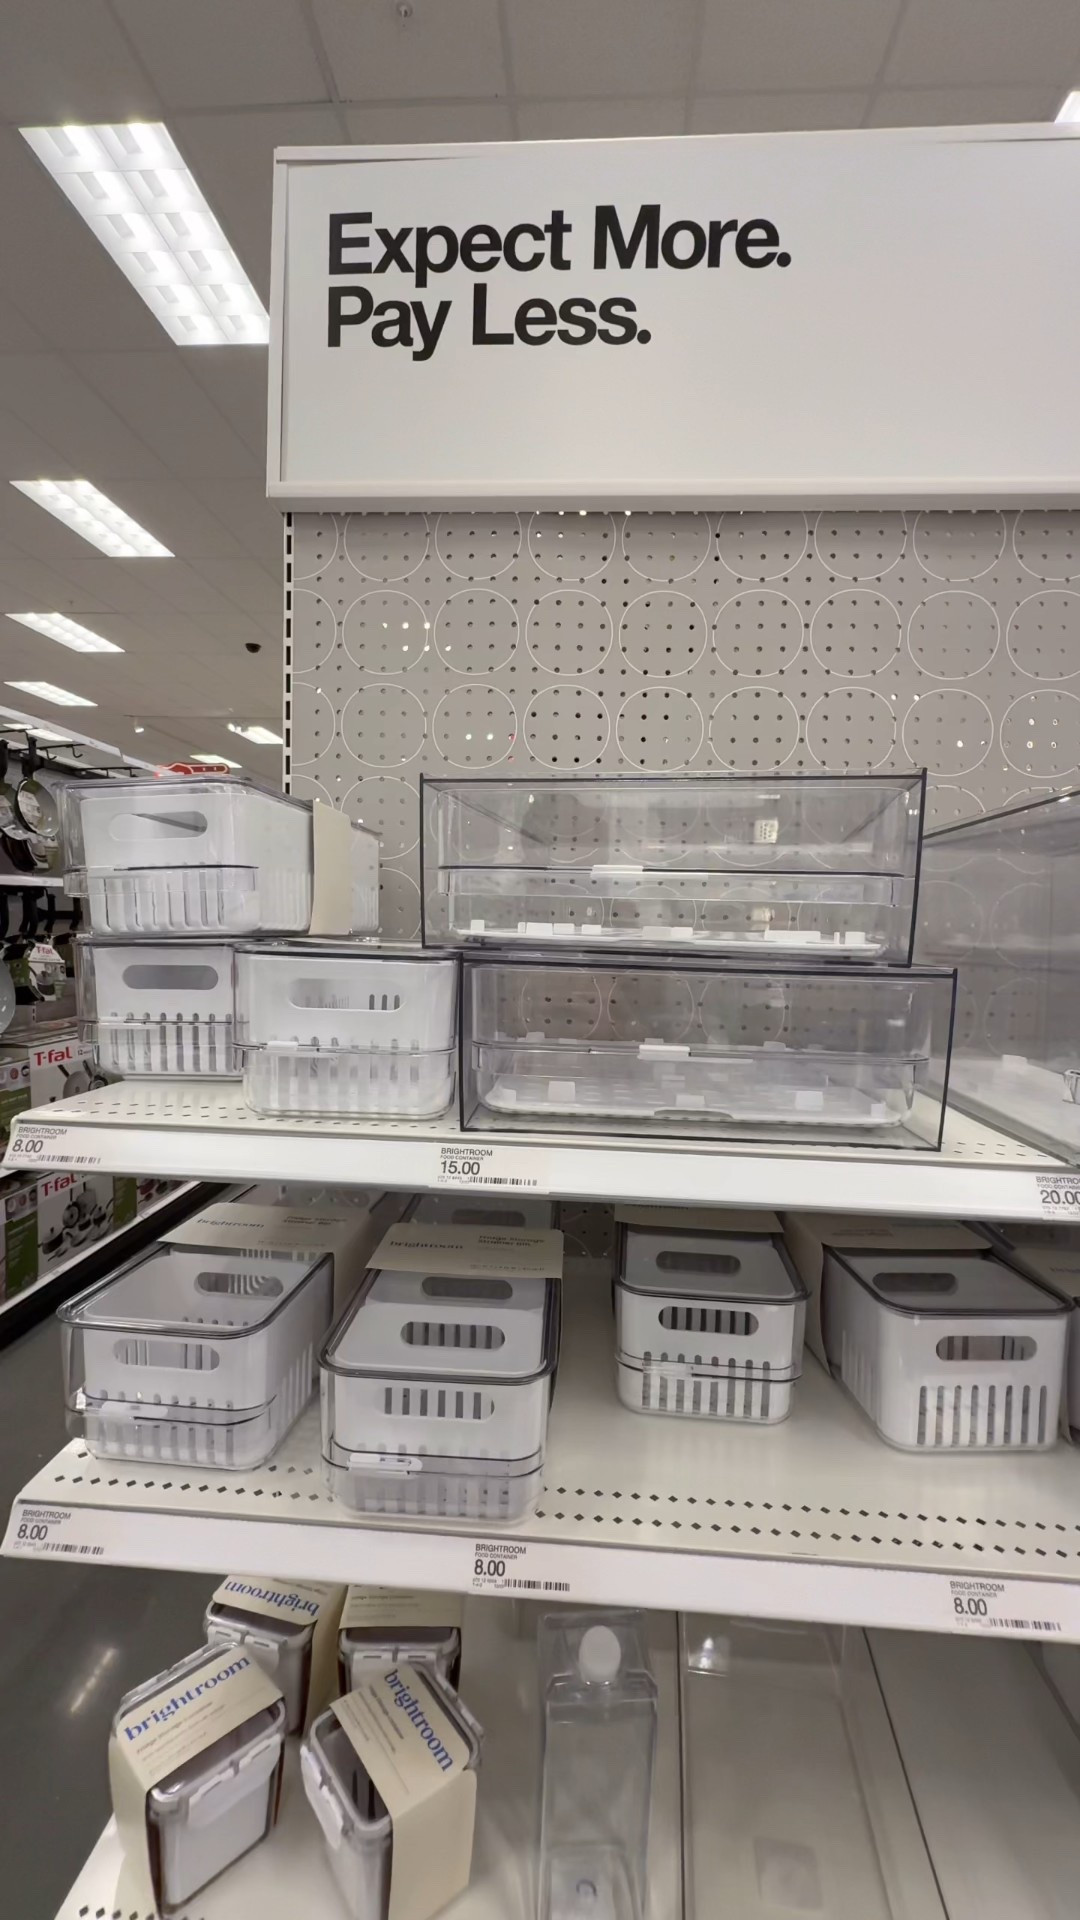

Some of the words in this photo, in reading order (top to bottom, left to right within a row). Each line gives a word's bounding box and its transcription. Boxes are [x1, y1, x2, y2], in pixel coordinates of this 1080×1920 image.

[329, 209, 573, 289] Expect
[593, 203, 792, 271] More.
[327, 285, 453, 362] Pay
[472, 282, 652, 347] Less.
[33, 1046, 73, 1066] T-fal
[18, 1126, 67, 1136] BRIGHTROOM
[12, 1138, 43, 1153] 8.00
[441, 1147, 493, 1157] BRIGHTROOM
[440, 1160, 480, 1176] 15.00
[41, 1172, 77, 1197] T-fal
[1035, 1175, 1080, 1185] BRIGHTRO
[22, 1509, 72, 1520] BRIGHTROOM
[17, 1523, 48, 1540] 8.00
[475, 1543, 527, 1554] BRIGHTROOM
[474, 1558, 506, 1577] 8.00
[950, 1580, 1005, 1592] BRIGHTROOM
[224, 1581, 320, 1616] brightroom
[953, 1597, 988, 1616] 8.00
[124, 1656, 251, 1741] brightroom
[384, 1668, 454, 1772] brightroom
